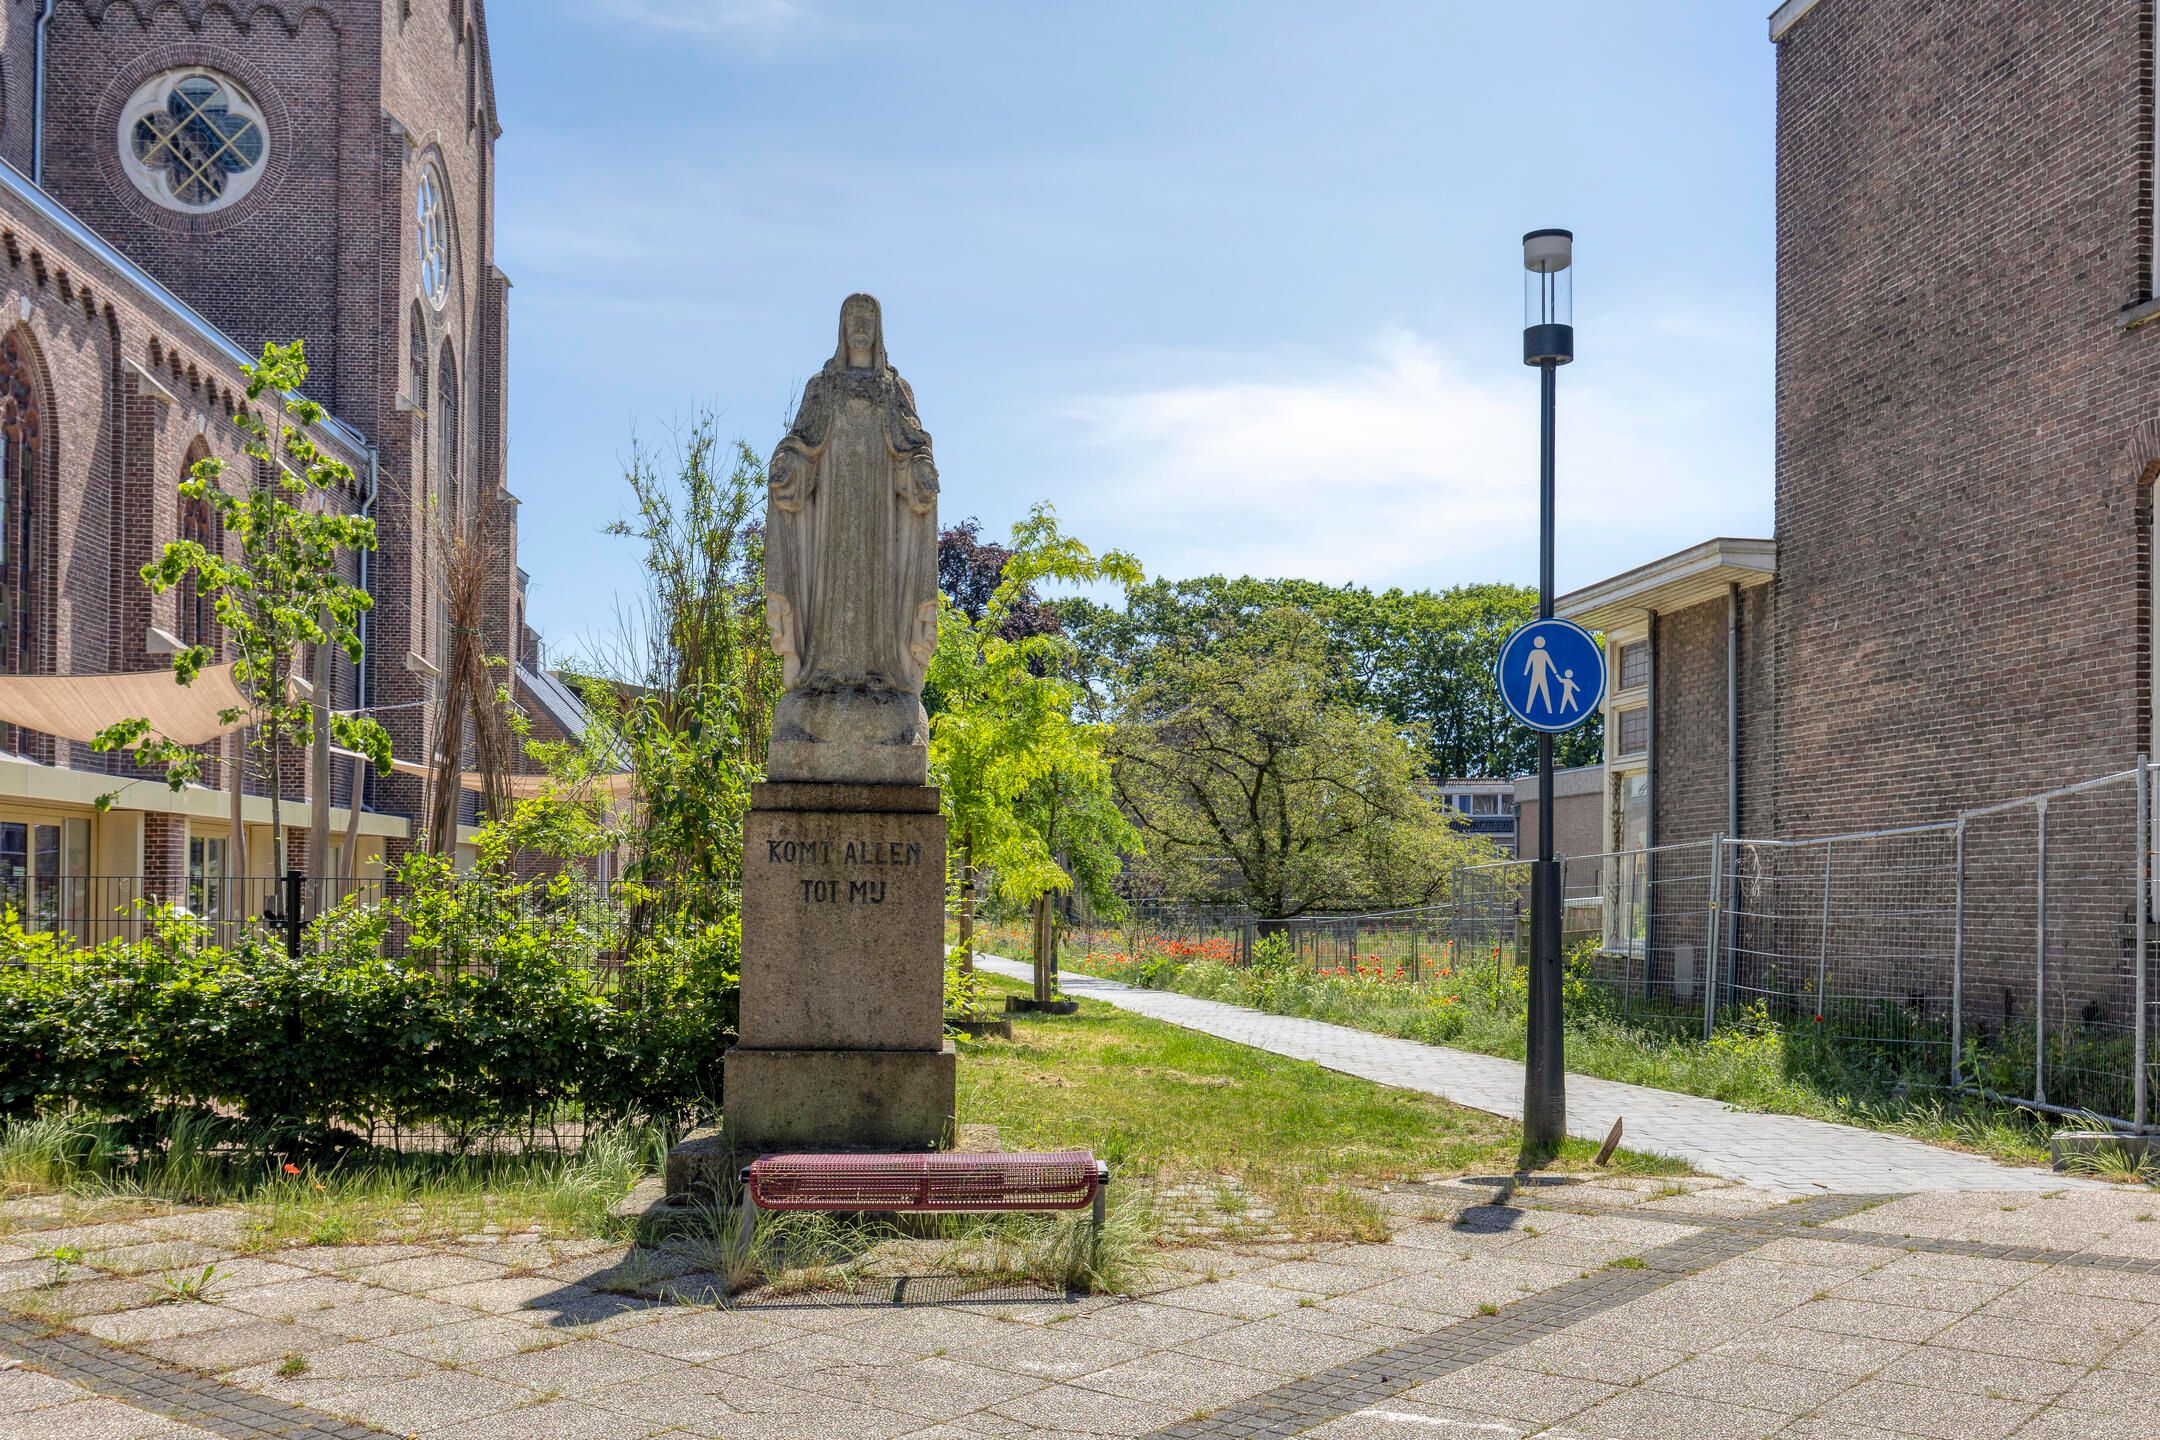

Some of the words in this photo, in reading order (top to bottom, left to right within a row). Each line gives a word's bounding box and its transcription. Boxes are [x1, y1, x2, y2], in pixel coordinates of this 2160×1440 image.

[767, 840, 834, 864] KOMT
[844, 840, 922, 865] ALLEN
[801, 879, 840, 904] TOT
